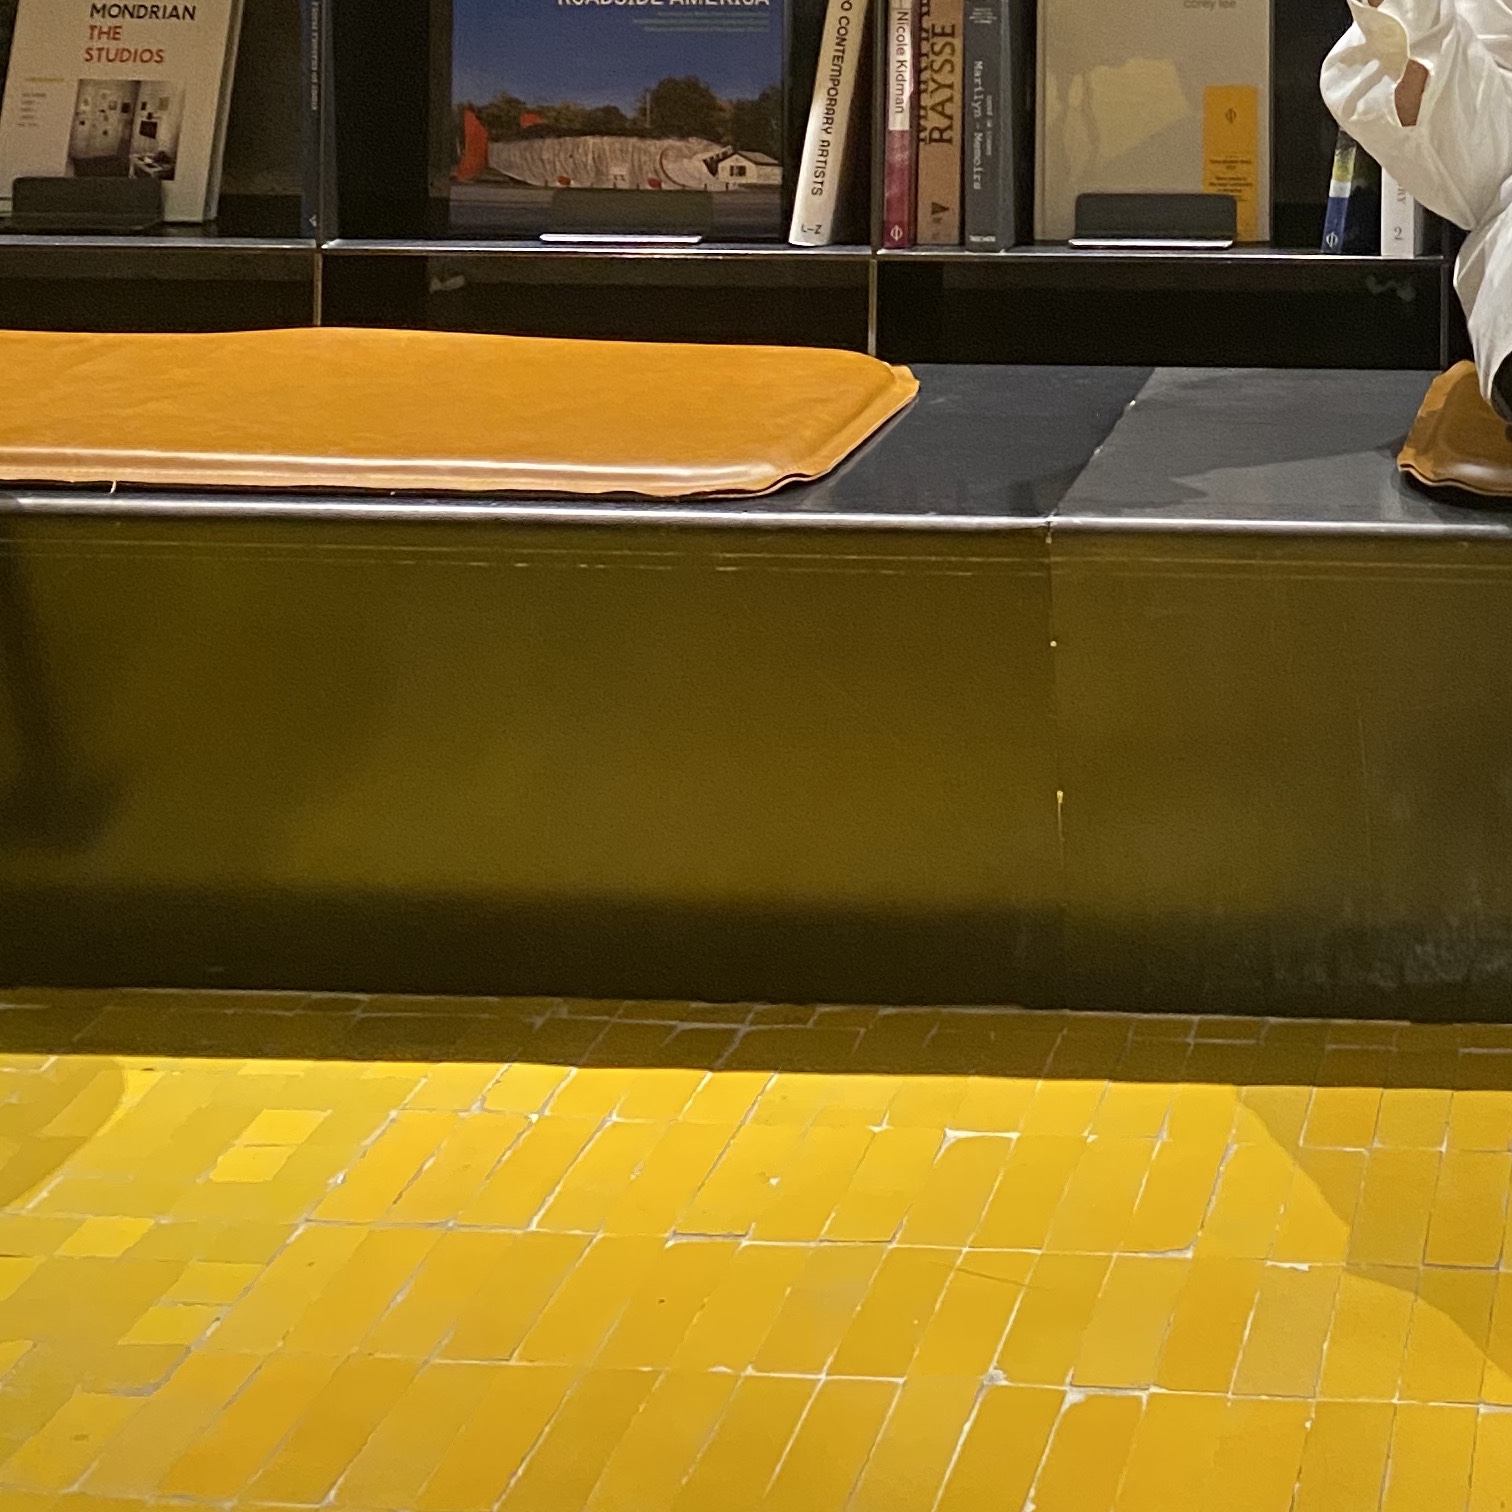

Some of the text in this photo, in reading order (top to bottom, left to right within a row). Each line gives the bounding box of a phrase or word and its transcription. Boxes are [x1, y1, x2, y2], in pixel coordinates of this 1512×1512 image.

[89, 25, 123, 41] THE
[90, 3, 197, 21] MONDRIAN
[84, 47, 166, 64] STUDIOS
[823, 16, 850, 135] CONTEMPORARY
[894, 11, 909, 114] Nicole Kidman
[928, 23, 956, 146] RAYSSE
[972, 60, 984, 190] Marilyn Memoirs
[811, 140, 832, 197] ARTISTS
[1394, 227, 1403, 241] 2
